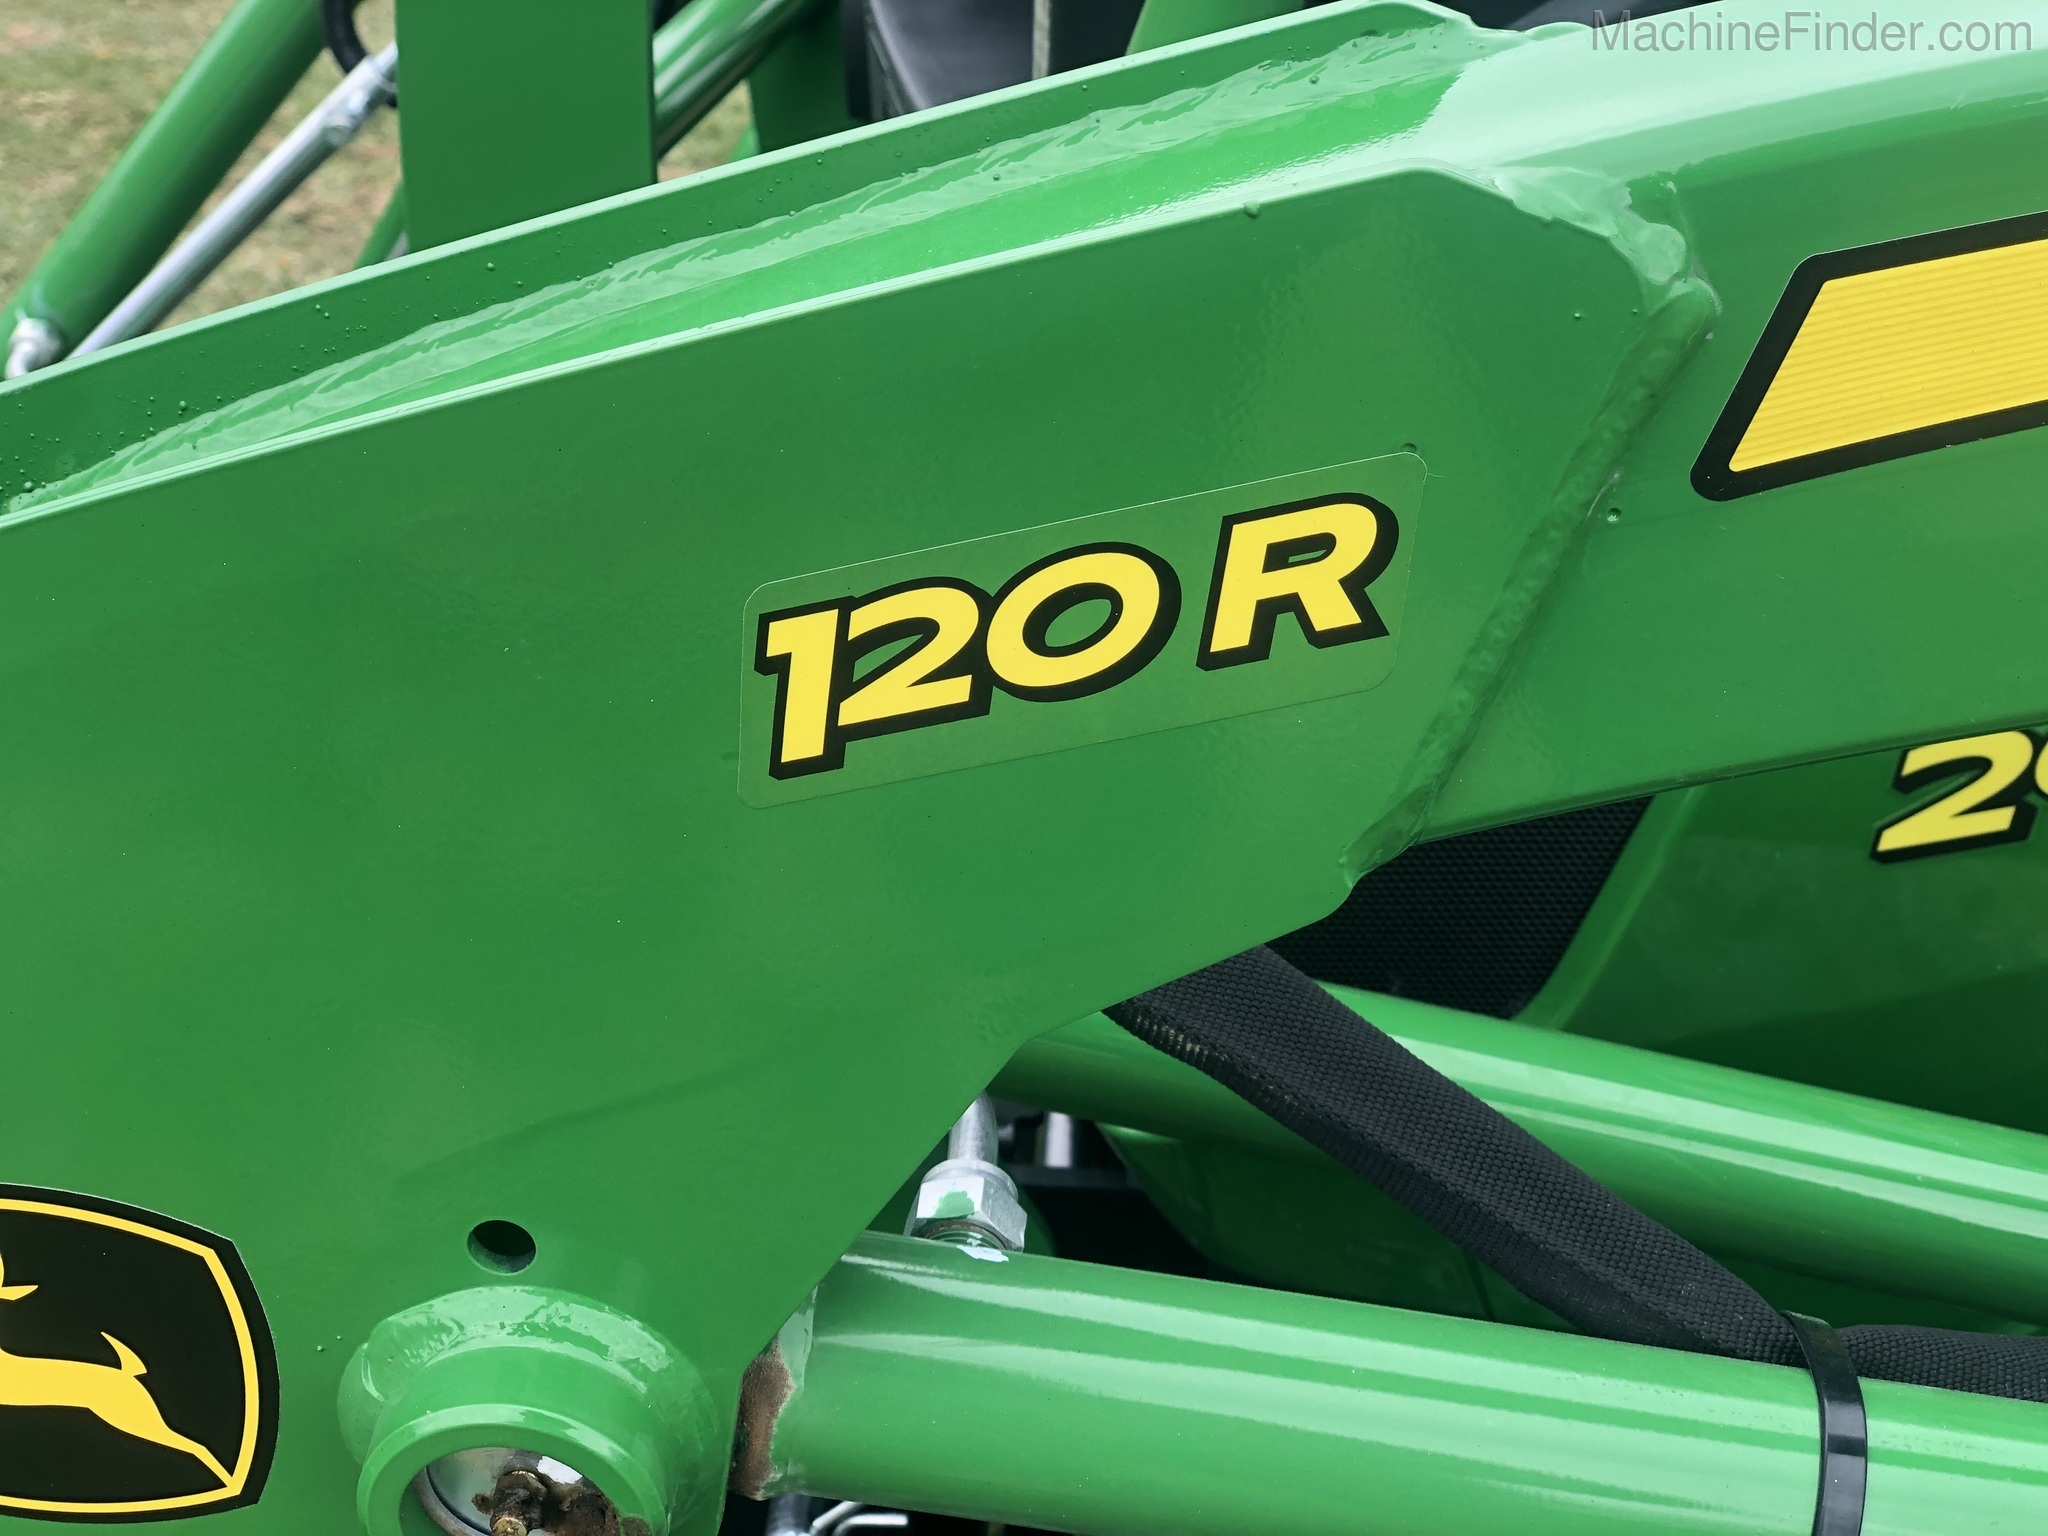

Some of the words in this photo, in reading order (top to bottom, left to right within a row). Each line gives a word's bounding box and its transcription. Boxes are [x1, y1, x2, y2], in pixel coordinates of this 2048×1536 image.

[756, 543, 1181, 779] 120
[1197, 492, 1398, 671] R
[1871, 730, 2048, 862] 2
